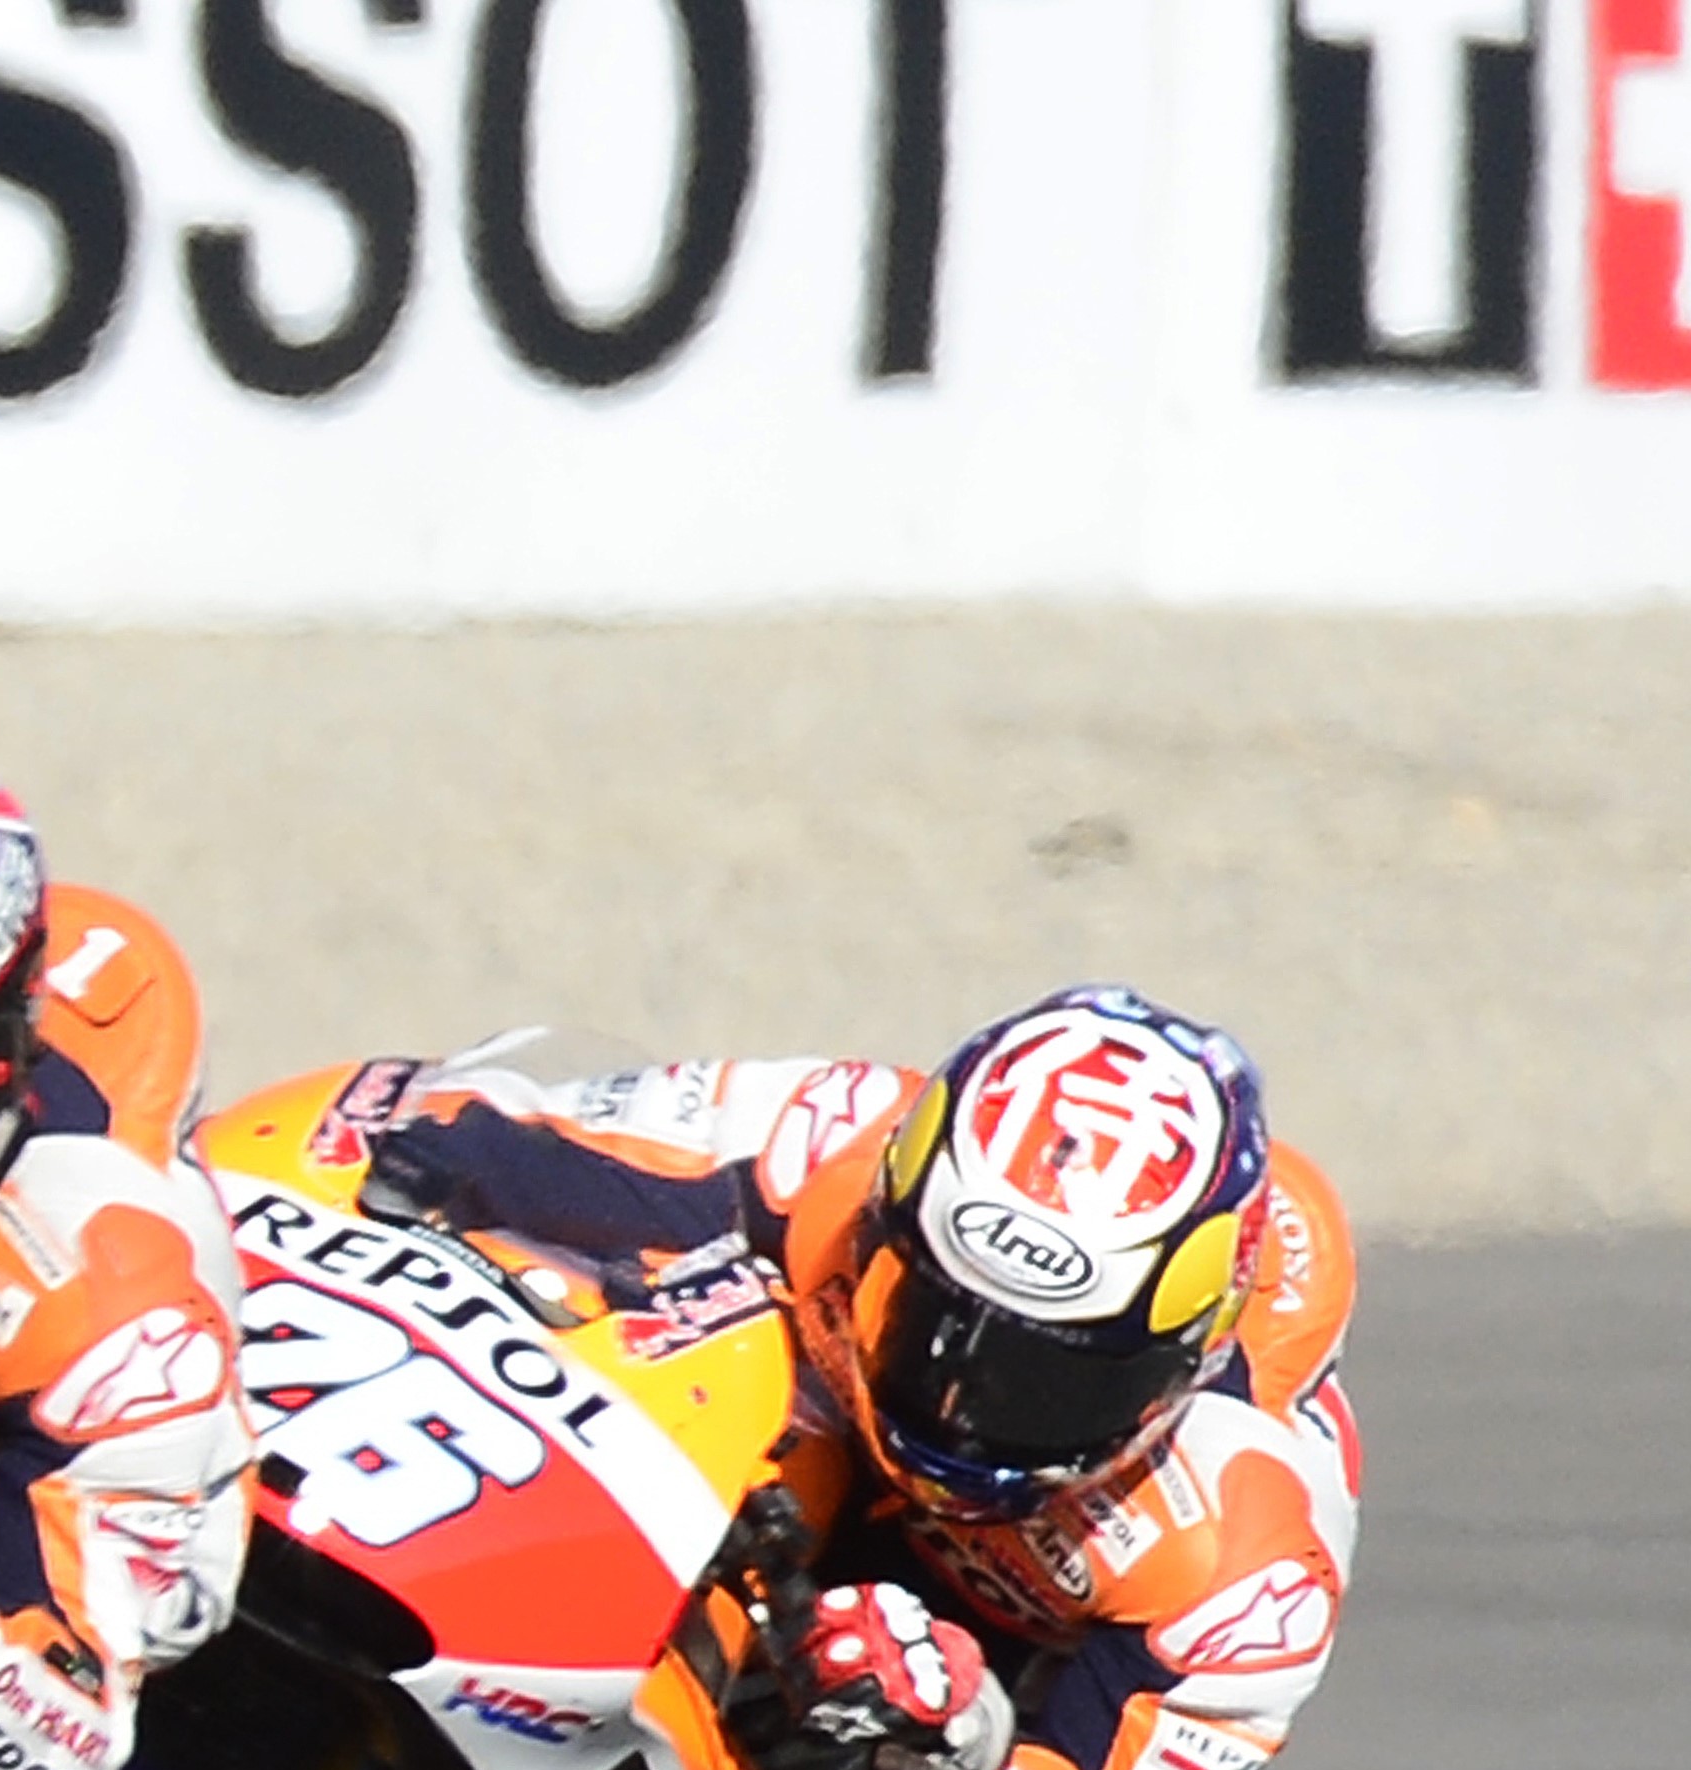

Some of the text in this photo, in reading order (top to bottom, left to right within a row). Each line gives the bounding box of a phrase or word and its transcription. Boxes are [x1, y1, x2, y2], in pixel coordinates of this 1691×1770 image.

[963, 1211, 1077, 1279] Arai
[235, 1193, 617, 1448] REPSOL
[443, 1676, 591, 1743] HRC
